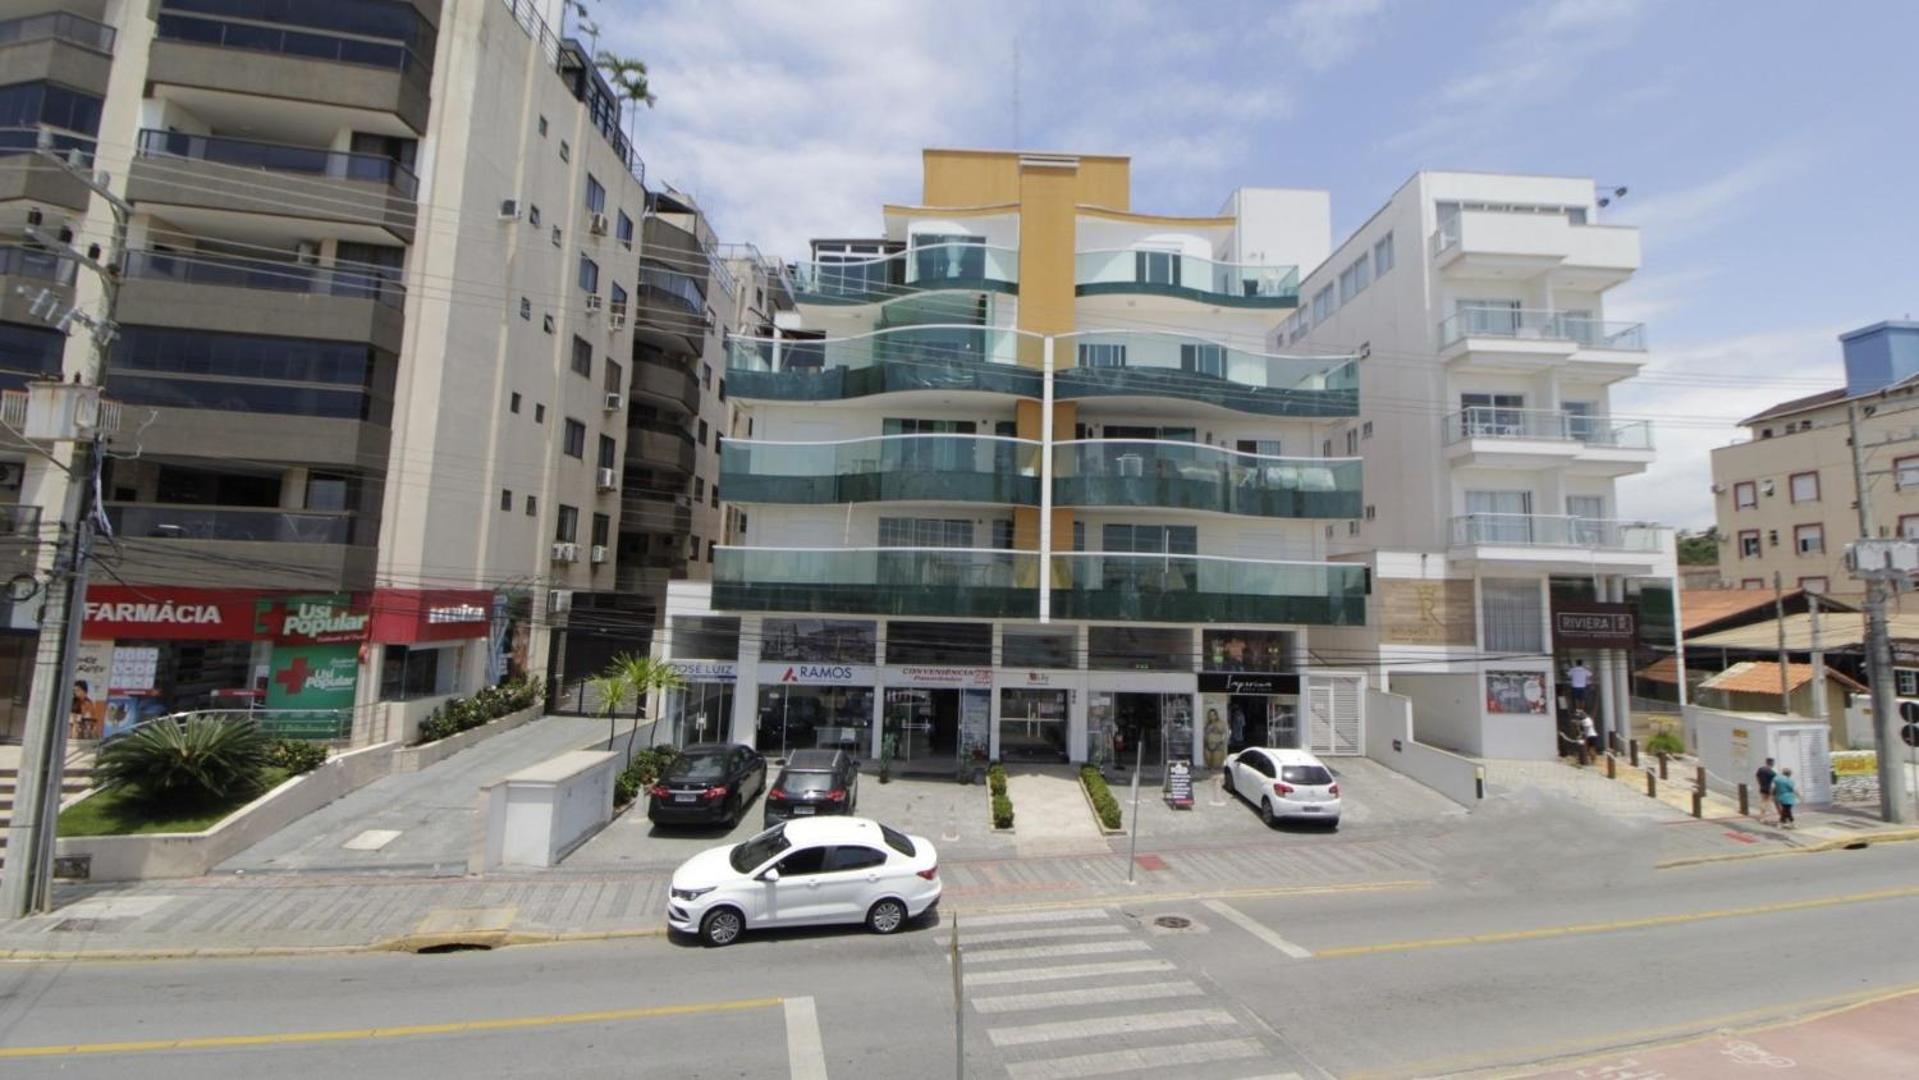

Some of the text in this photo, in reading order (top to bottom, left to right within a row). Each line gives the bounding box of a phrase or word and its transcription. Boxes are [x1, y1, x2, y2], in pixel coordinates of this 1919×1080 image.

[83, 600, 222, 624] FARMÁCIA
[299, 600, 332, 619] Usi
[283, 612, 369, 638] Popular
[1563, 616, 1609, 631] RIVIERA
[705, 664, 733, 675] LUIZ
[800, 667, 852, 679] RAMOS
